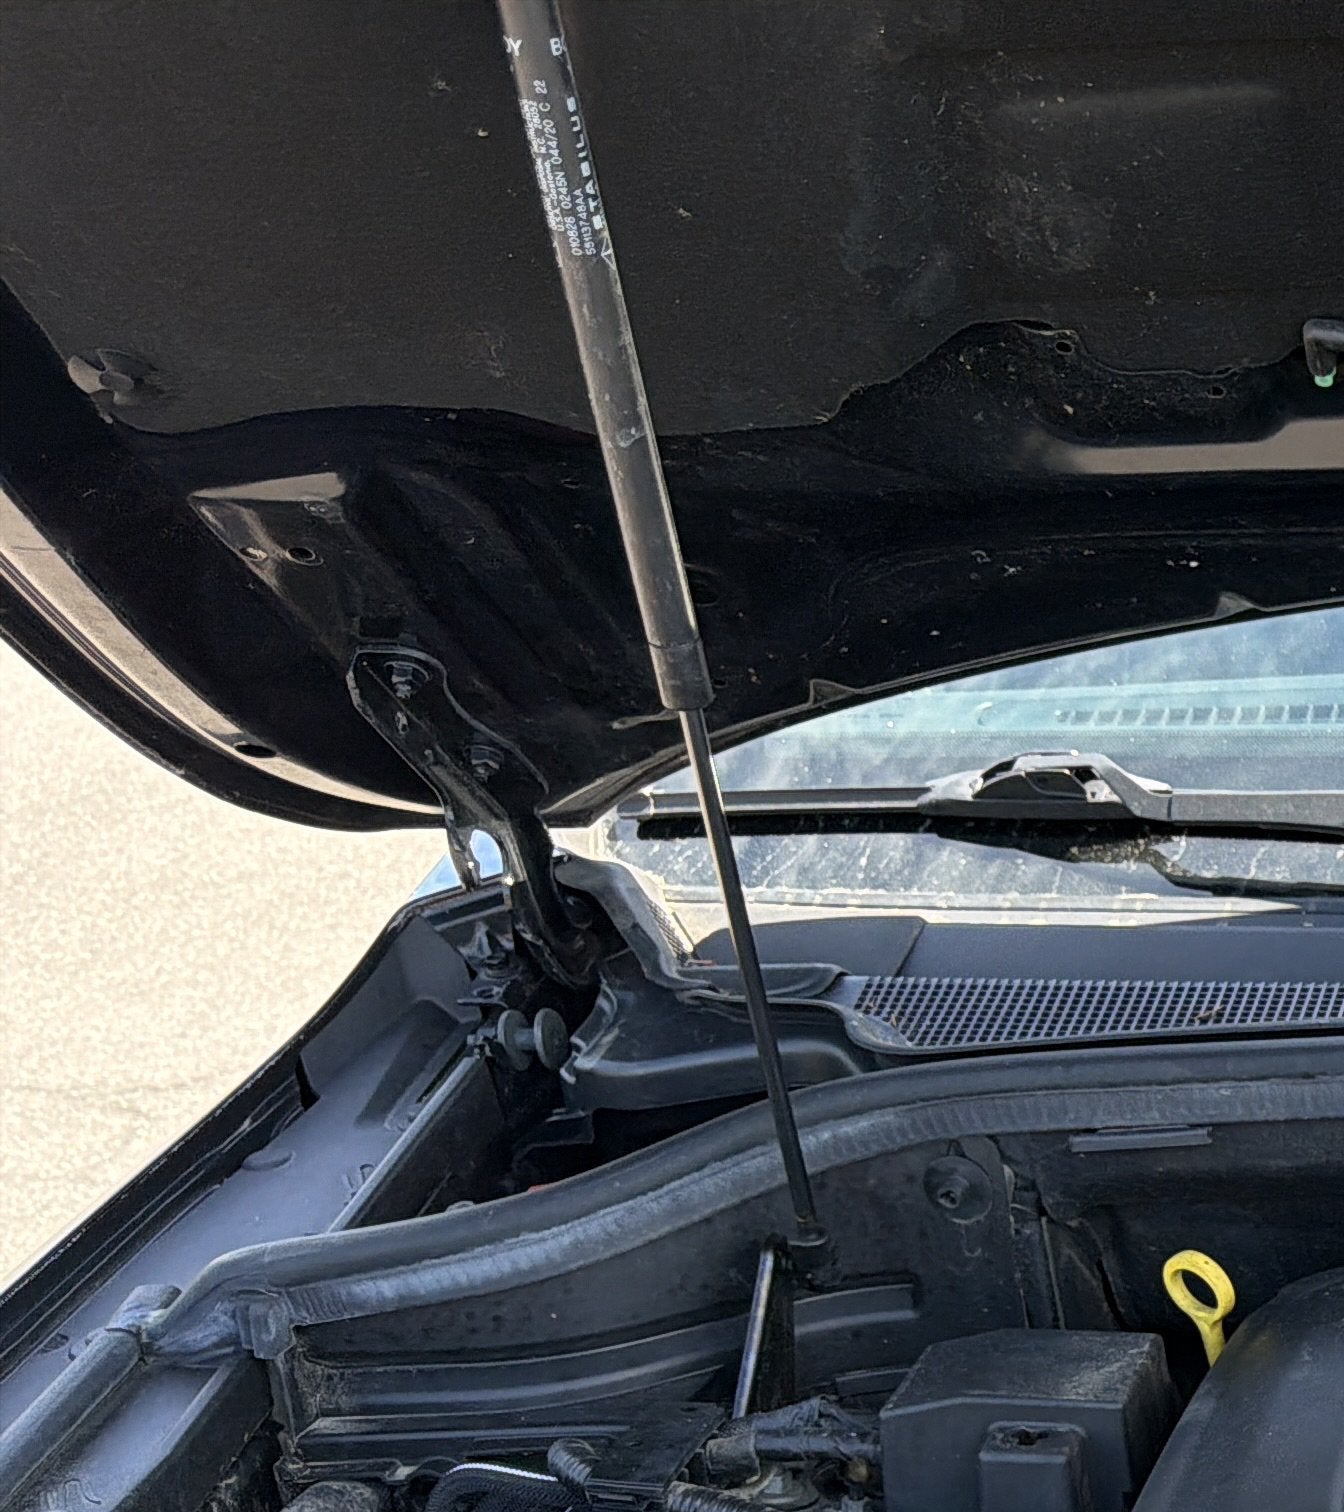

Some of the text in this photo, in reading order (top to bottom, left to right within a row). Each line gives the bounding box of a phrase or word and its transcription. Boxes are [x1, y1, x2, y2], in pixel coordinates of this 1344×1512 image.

[533, 79, 548, 95] 22
[544, 119, 563, 165] 044/20
[566, 96, 604, 230] STABILUS
[554, 171, 572, 210] 0245N
